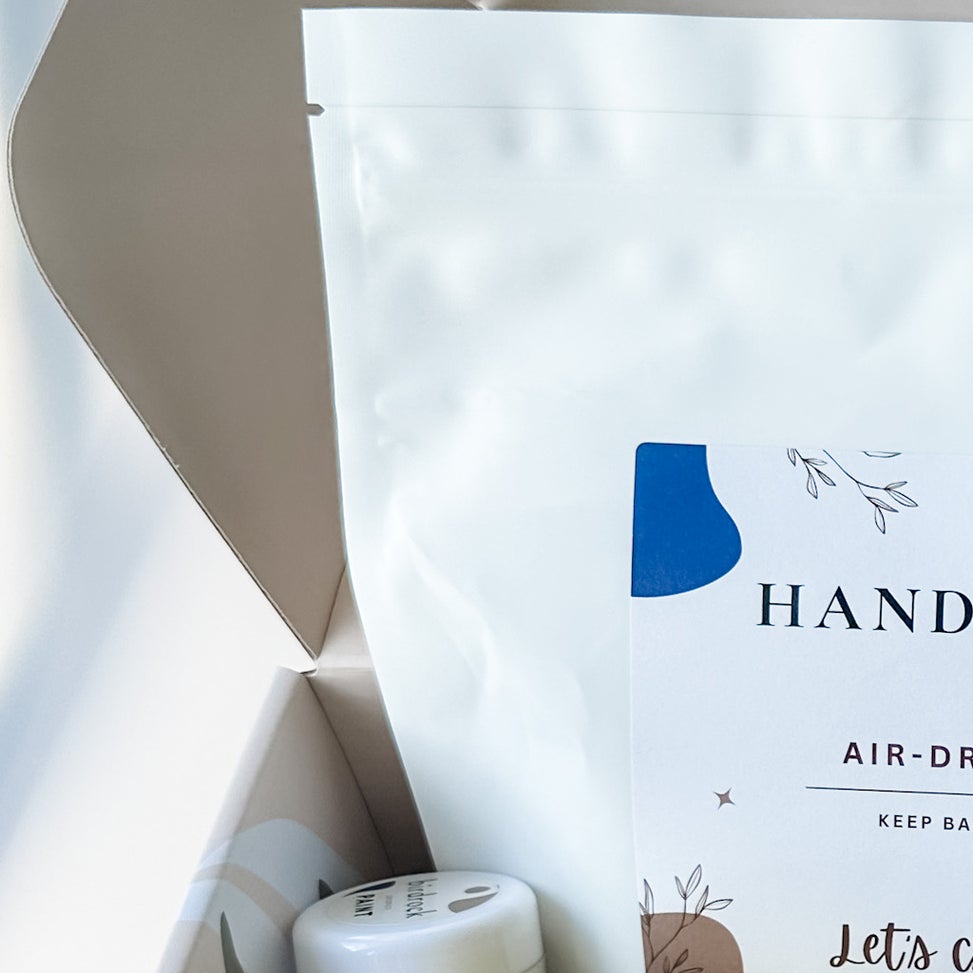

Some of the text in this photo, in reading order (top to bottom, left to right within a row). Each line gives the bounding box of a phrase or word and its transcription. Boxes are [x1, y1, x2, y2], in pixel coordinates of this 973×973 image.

[878, 813, 932, 830] KEEP
[353, 893, 376, 917] PAINT
[829, 922, 938, 971] Let's
